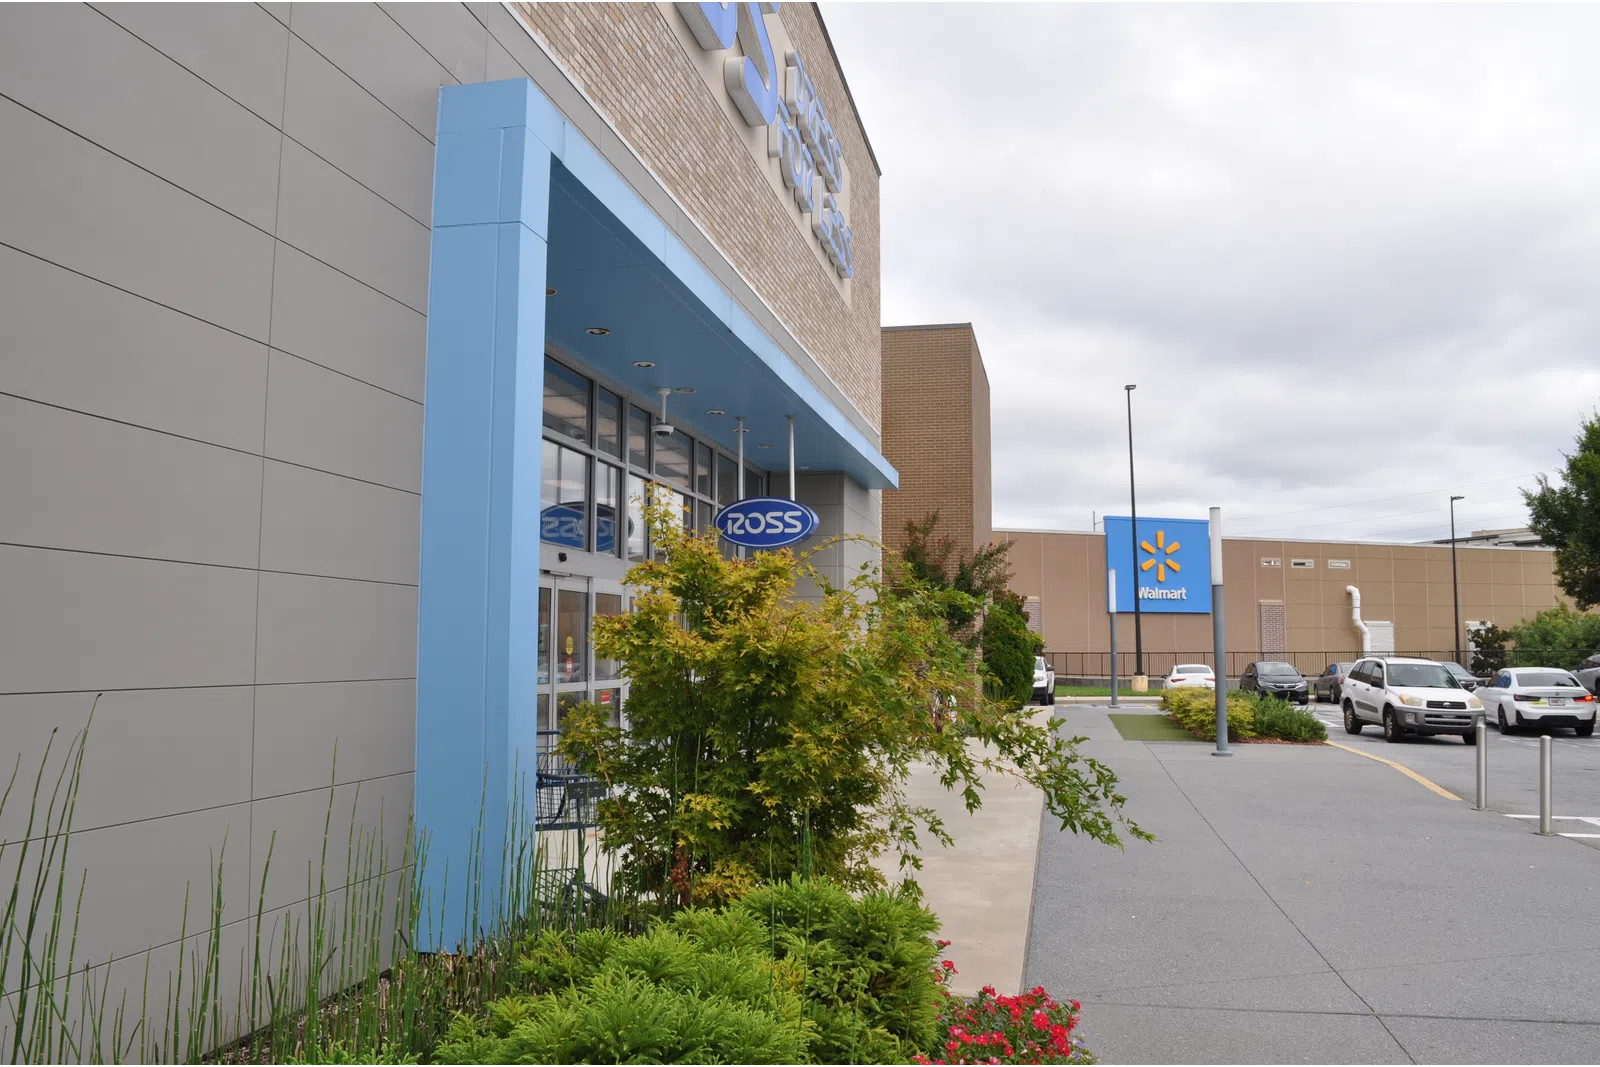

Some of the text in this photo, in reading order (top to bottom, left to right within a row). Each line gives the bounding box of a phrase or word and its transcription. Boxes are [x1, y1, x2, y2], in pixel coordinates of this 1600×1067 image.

[786, 48, 843, 193] DRESS
[812, 175, 853, 280] LESS
[727, 511, 802, 535] ROSS
[1138, 587, 1187, 600] Walmart
